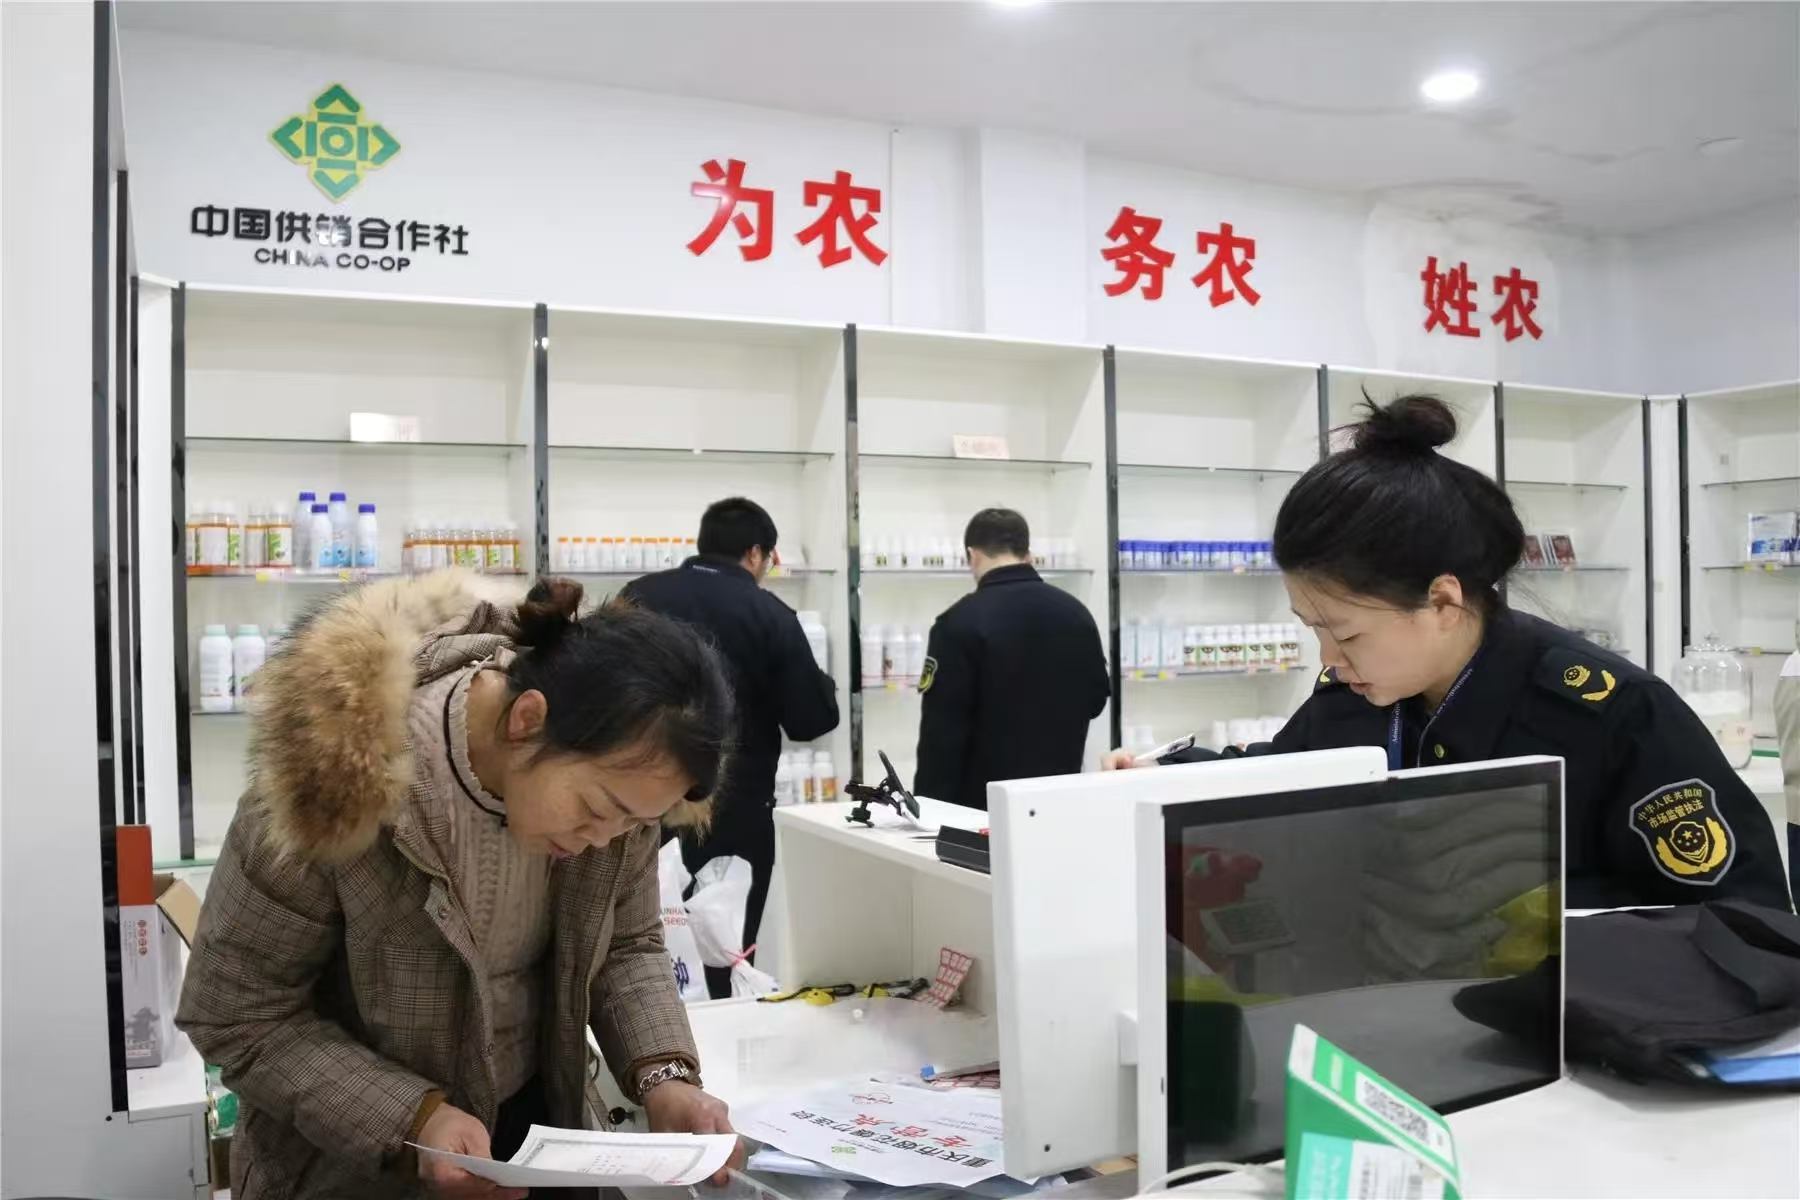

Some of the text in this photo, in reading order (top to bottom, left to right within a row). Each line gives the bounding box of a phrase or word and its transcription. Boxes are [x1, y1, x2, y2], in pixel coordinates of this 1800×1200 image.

[190, 203, 469, 256] 中国供销合作社
[254, 248, 411, 272] CHINA CO-OP
[686, 158, 1544, 342] 为农 务农 姓农
[1637, 788, 1703, 821] 中华人民共和国
[1647, 799, 1705, 828] 市场监管执法
